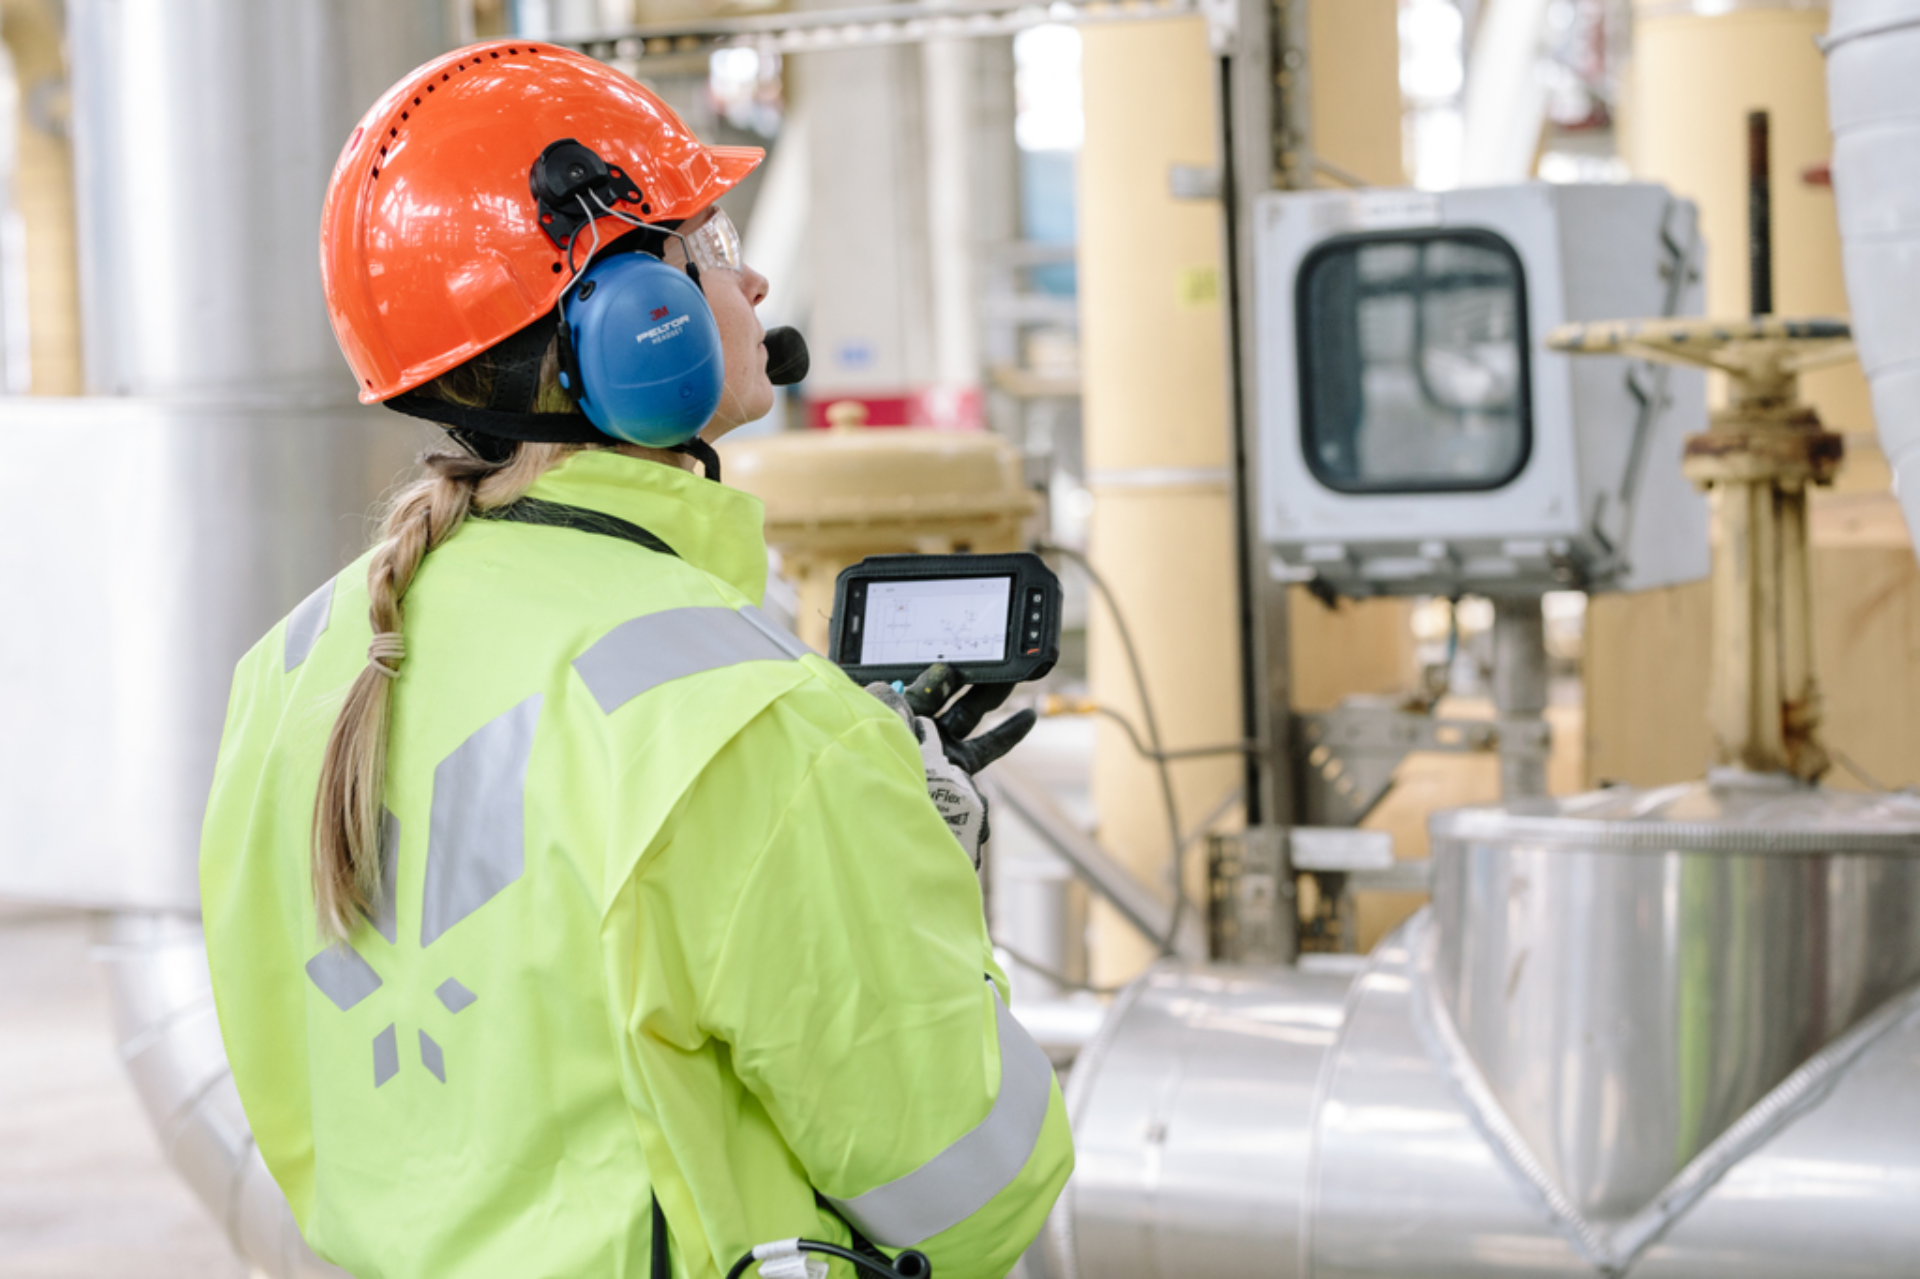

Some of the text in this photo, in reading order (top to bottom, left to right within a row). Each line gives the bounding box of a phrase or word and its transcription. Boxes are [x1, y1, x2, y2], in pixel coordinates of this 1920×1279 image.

[649, 305, 669, 321] 3M
[636, 314, 690, 343] PELTOR
[652, 326, 683, 344] HEADSET
